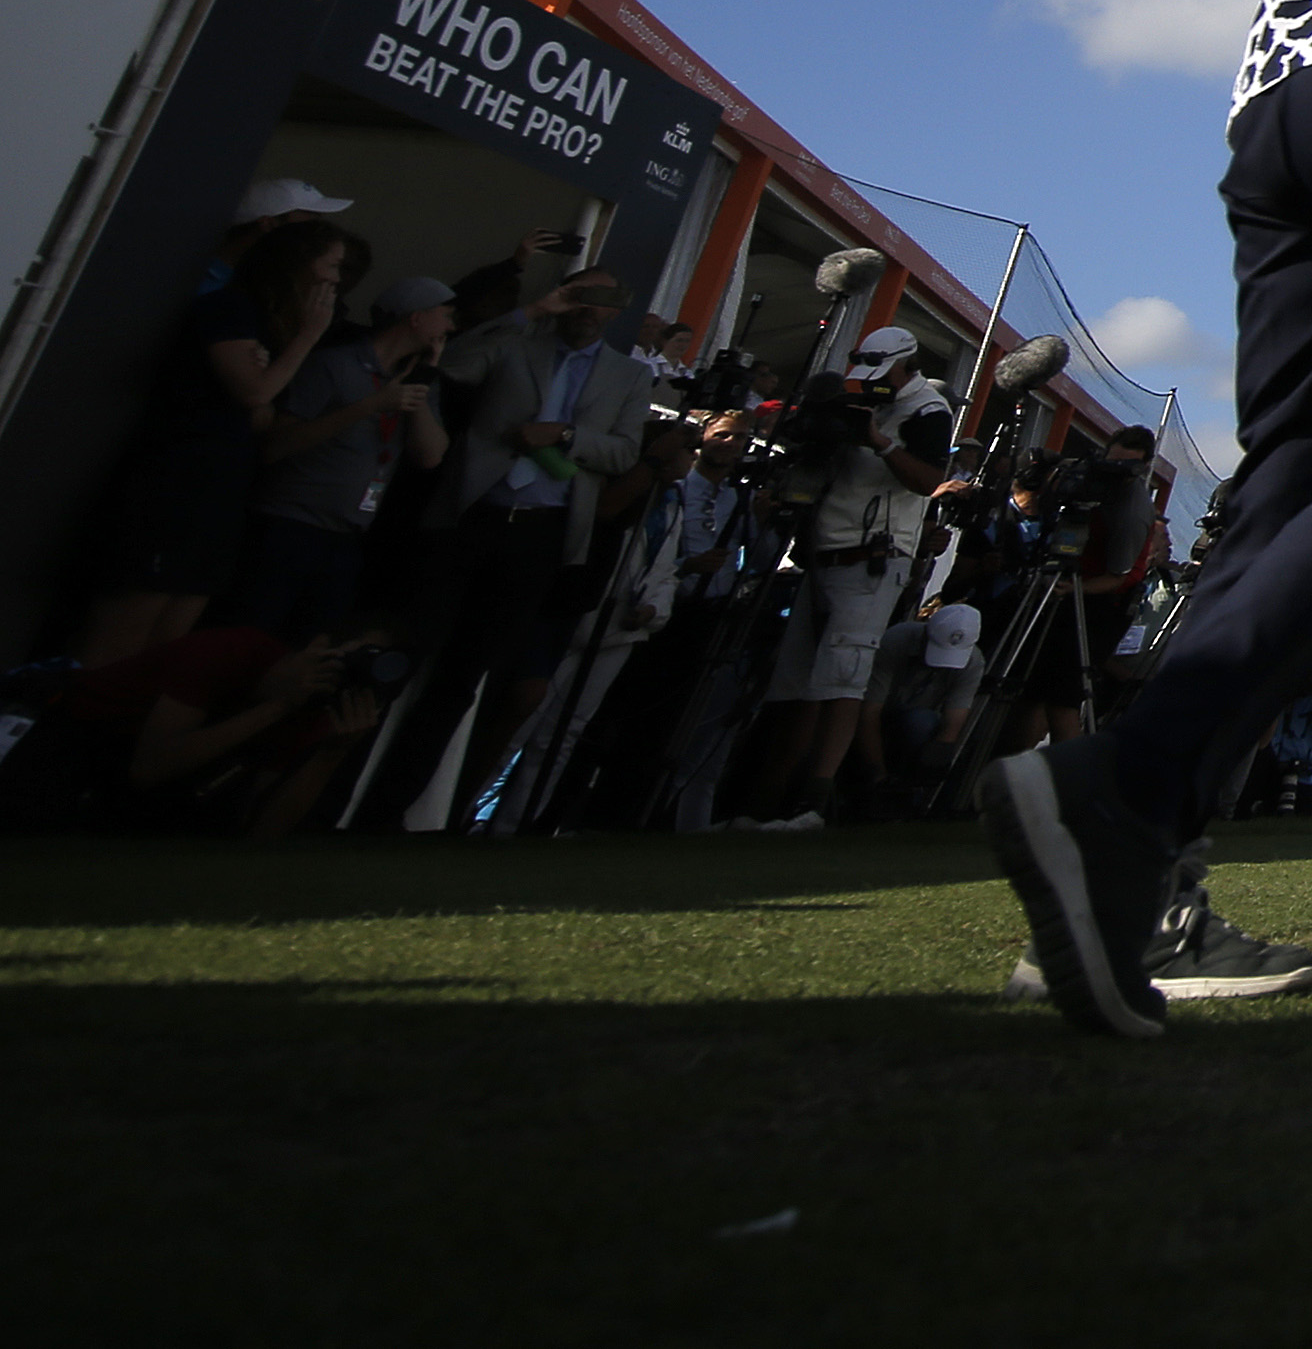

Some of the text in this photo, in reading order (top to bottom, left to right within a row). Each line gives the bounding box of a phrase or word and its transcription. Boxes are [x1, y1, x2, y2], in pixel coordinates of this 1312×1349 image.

[365, 33, 602, 164] BEAT THE PRO?
[528, 41, 628, 125] CAN
[662, 130, 693, 154] KLM
[645, 160, 671, 181] ING
